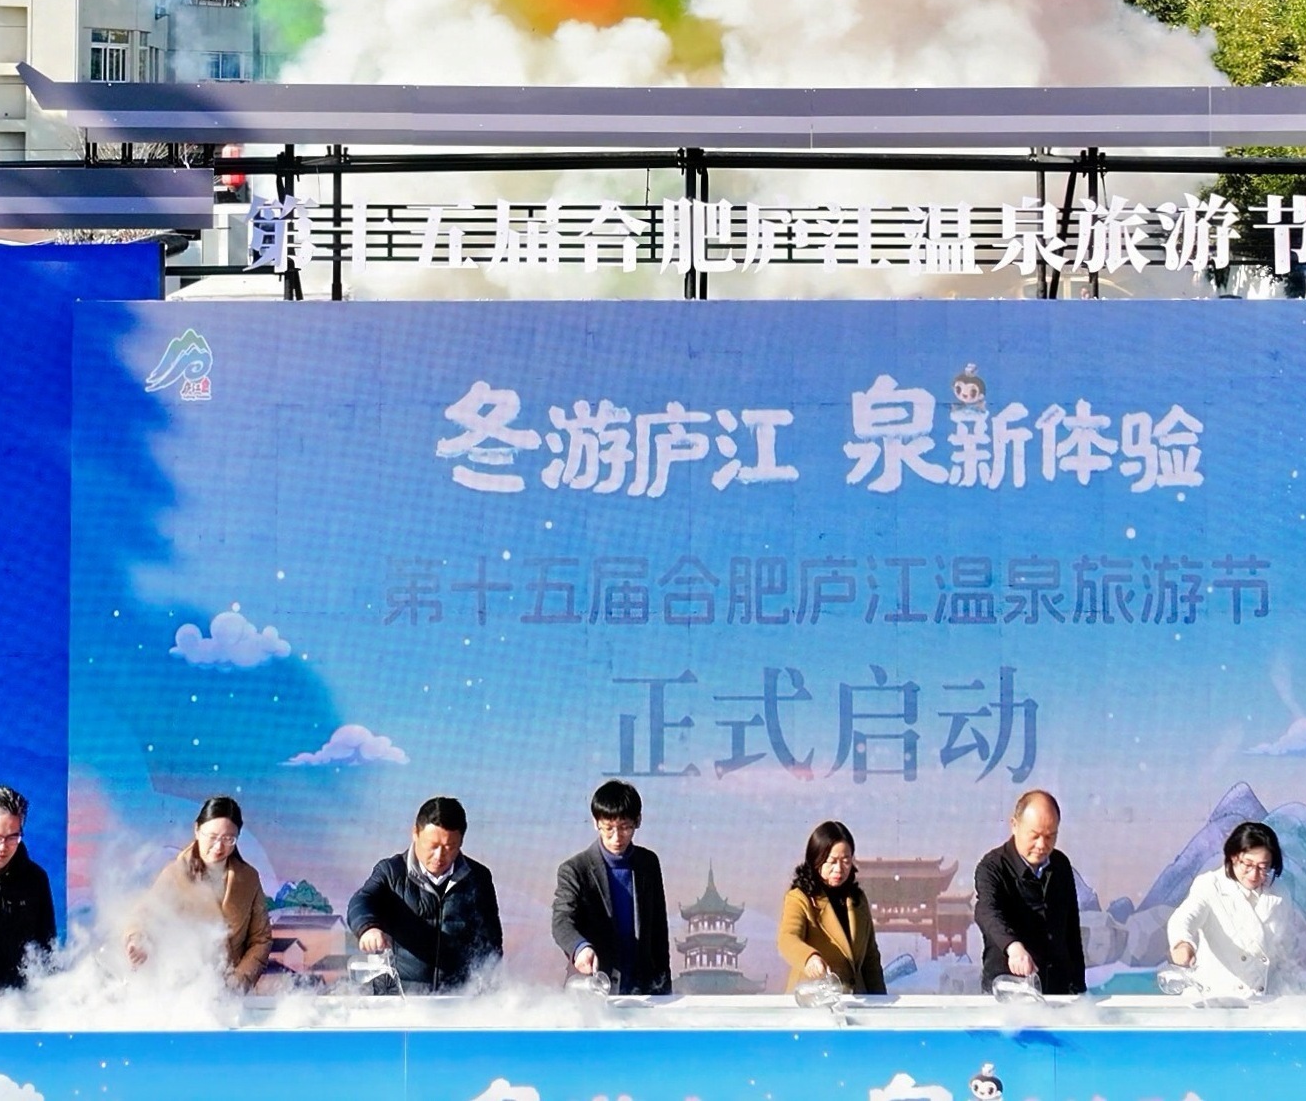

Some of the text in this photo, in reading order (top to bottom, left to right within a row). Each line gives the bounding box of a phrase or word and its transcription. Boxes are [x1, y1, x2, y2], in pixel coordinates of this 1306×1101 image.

[436, 374, 1204, 497] 冬游庐江 泉新体验
[383, 554, 1272, 626] 第十五届合肥庐江温泉旅游节
[601, 664, 1039, 784] 正式启动
